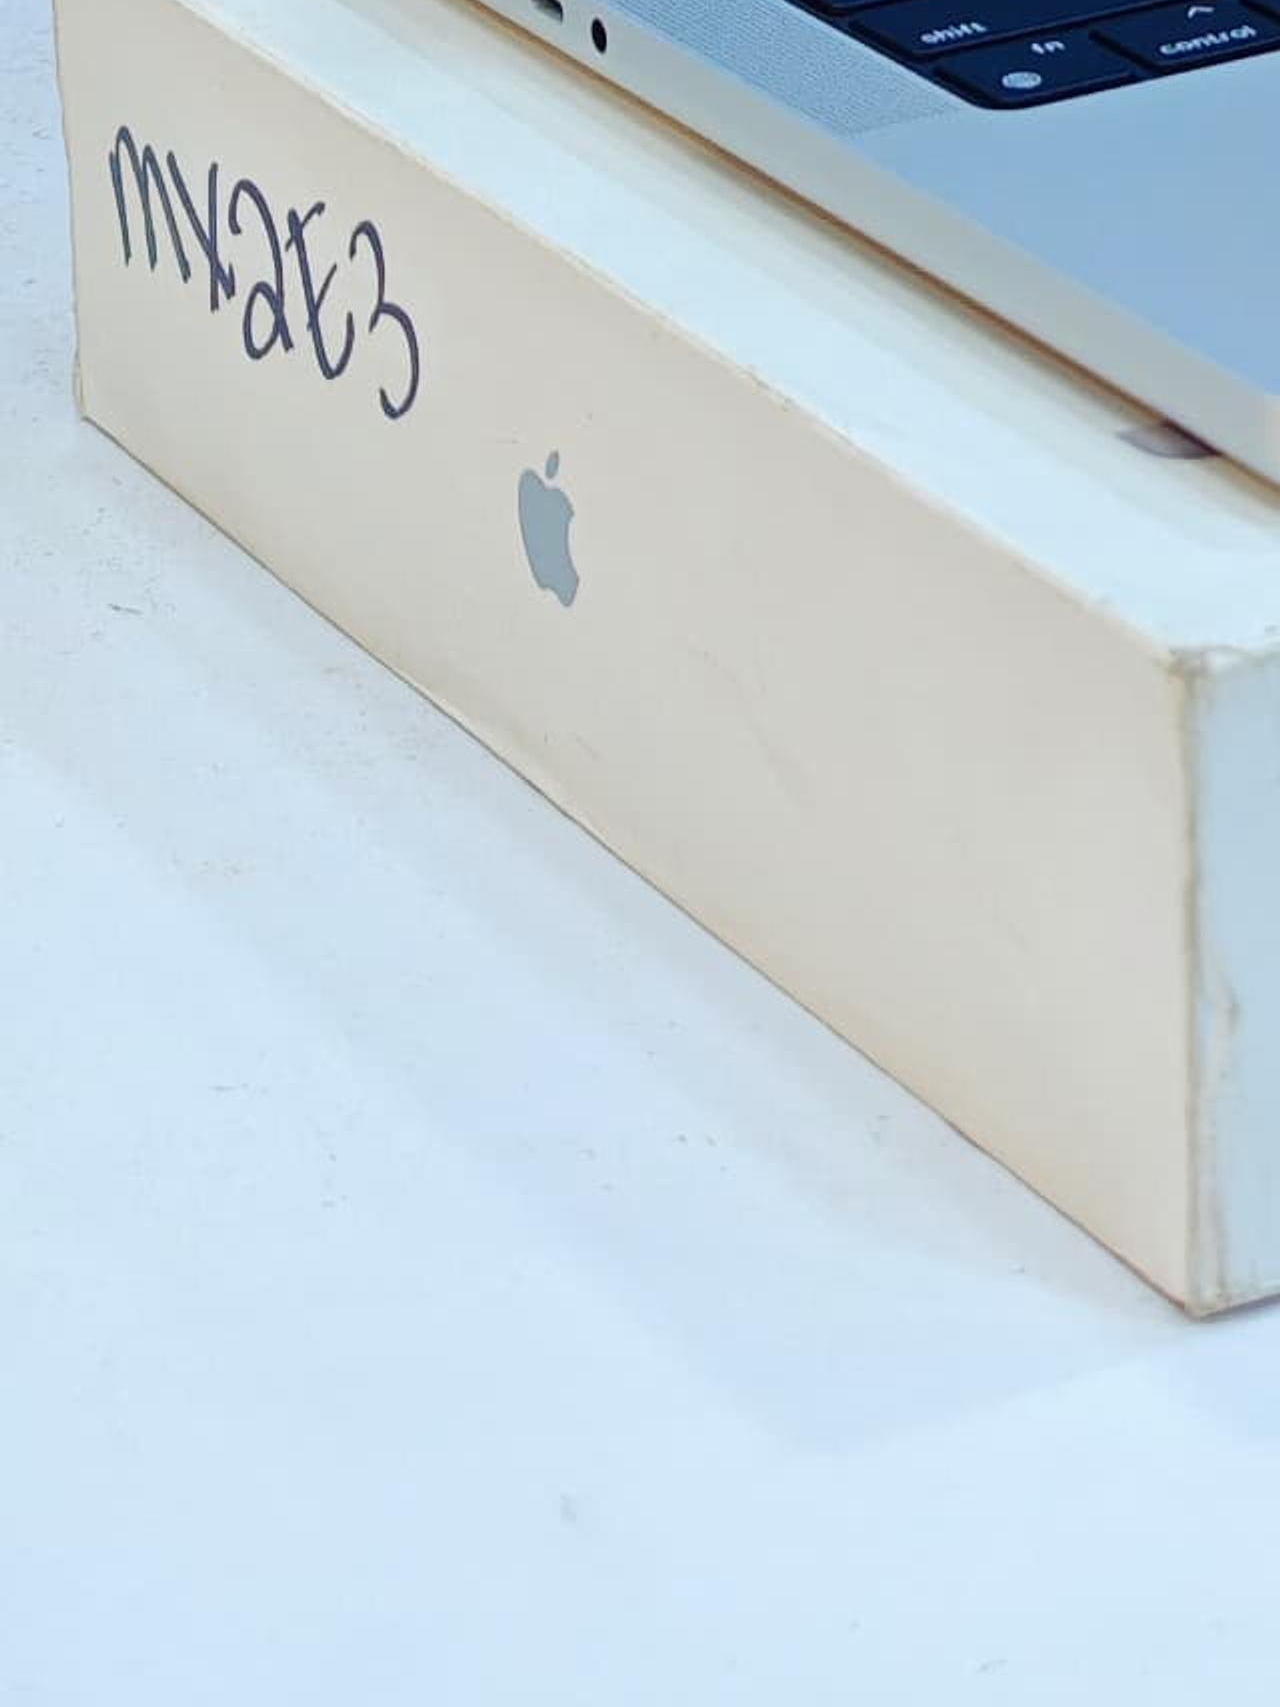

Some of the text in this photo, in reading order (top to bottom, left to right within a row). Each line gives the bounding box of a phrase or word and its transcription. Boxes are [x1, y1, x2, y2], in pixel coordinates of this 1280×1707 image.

[920, 22, 987, 44] shift
[1159, 25, 1257, 55] control
[1031, 40, 1065, 55] fn
